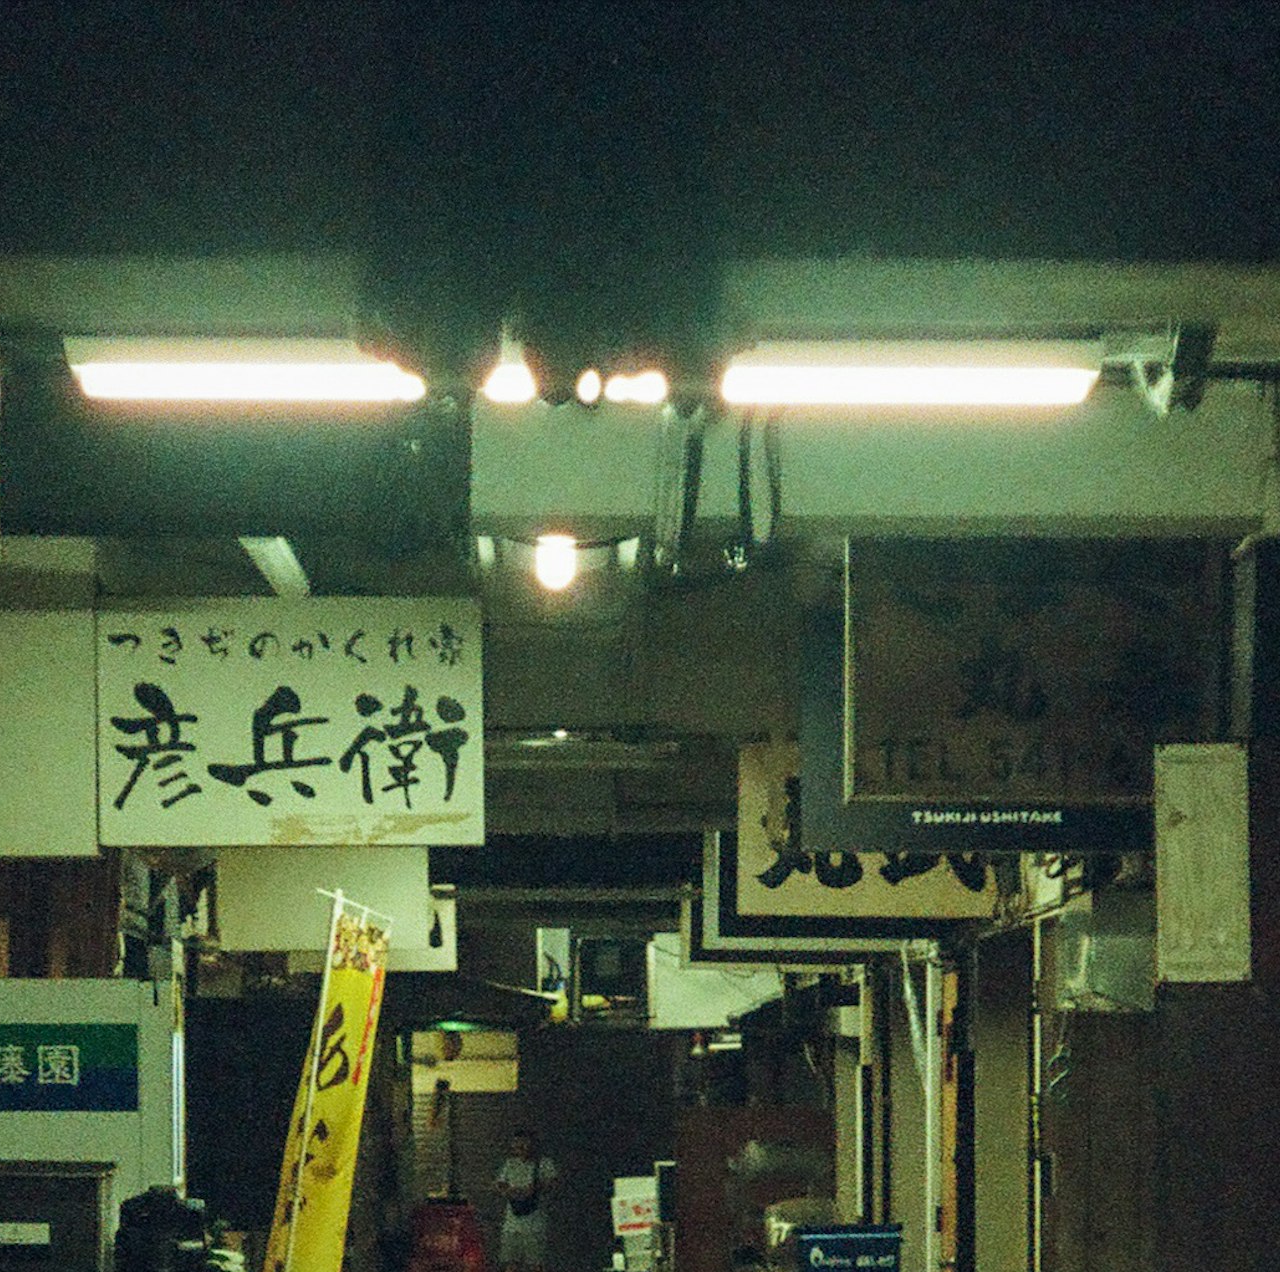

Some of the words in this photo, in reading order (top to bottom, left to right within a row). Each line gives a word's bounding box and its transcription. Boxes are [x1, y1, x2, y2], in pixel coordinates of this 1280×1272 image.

[109, 681, 470, 810] 彦兵衛
[911, 809, 977, 824] TSUKIJI
[980, 809, 1063, 824] USHITAKE
